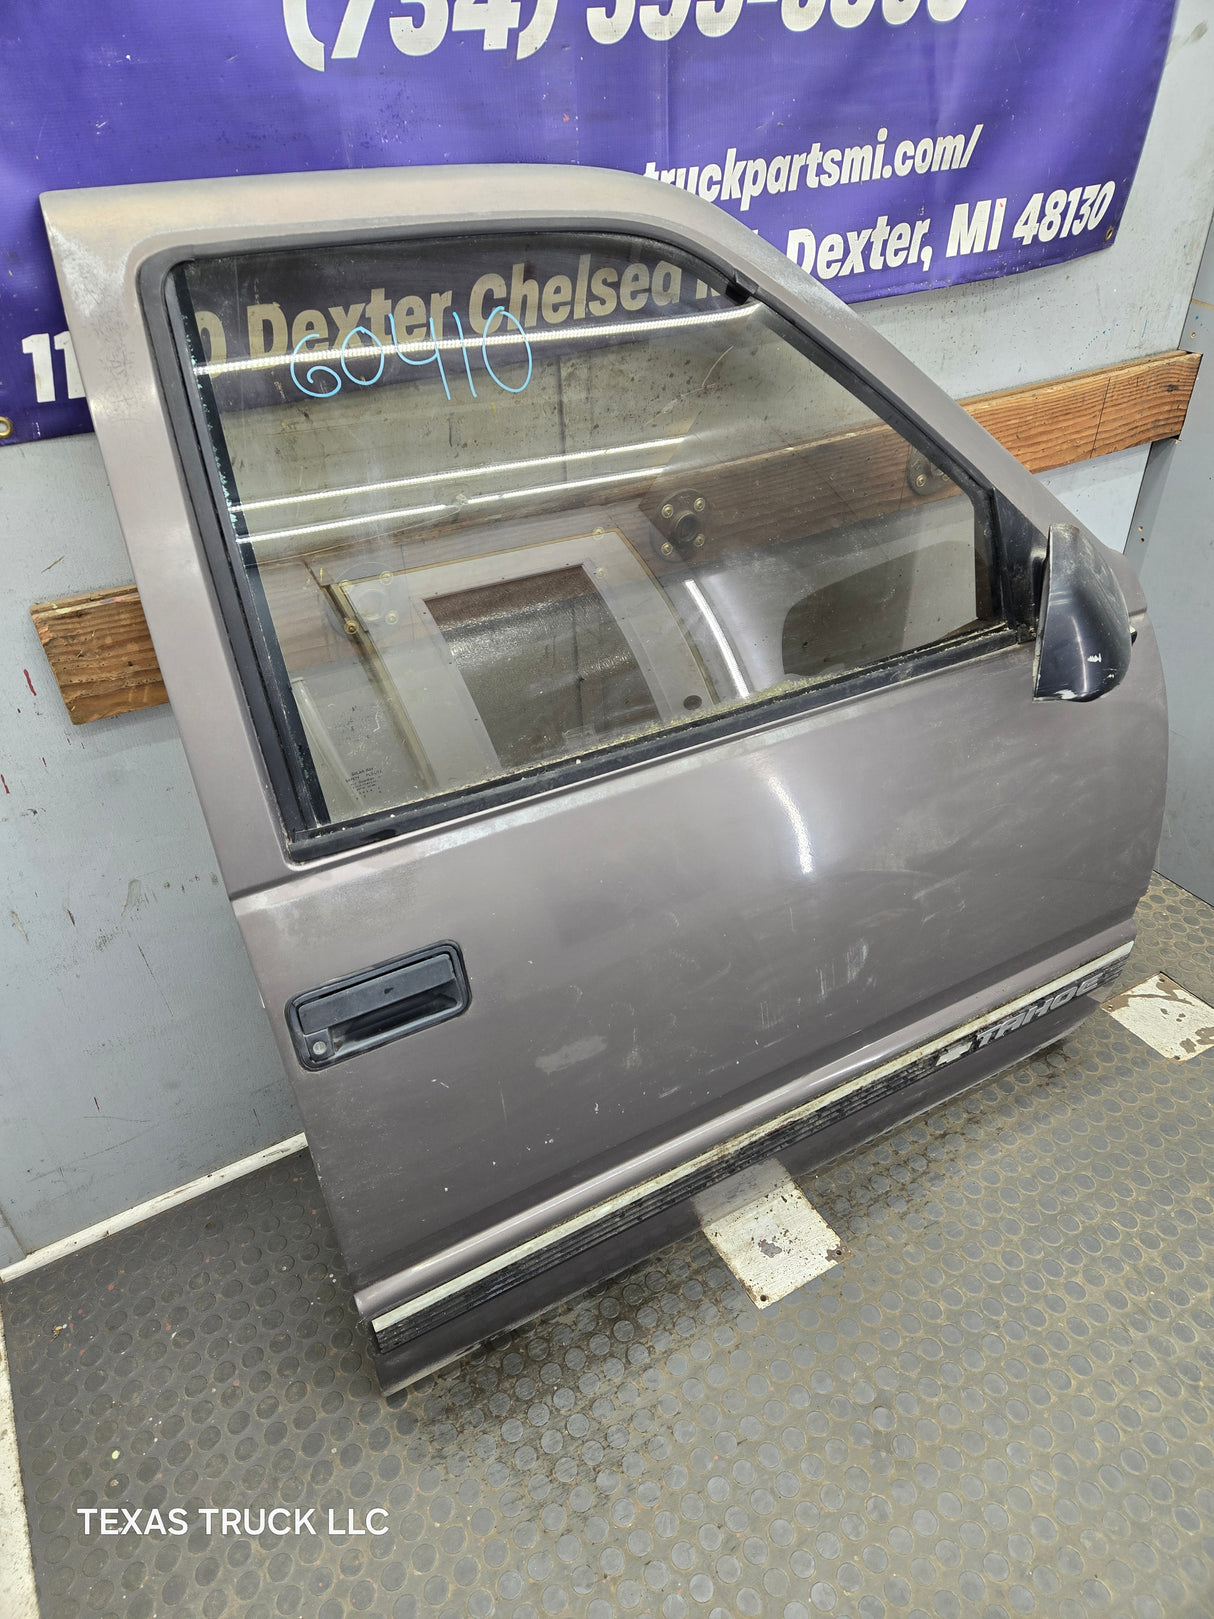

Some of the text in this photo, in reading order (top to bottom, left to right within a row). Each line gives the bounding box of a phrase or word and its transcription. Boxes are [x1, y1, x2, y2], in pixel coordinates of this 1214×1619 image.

[246, 287, 453, 371] Dexter
[468, 254, 683, 335] Chelsea
[786, 215, 933, 280] Dexter,
[945, 197, 1008, 258] MI
[1012, 180, 1116, 246] 48130
[290, 305, 533, 400] 60410
[976, 971, 1104, 1048] TAHOE
